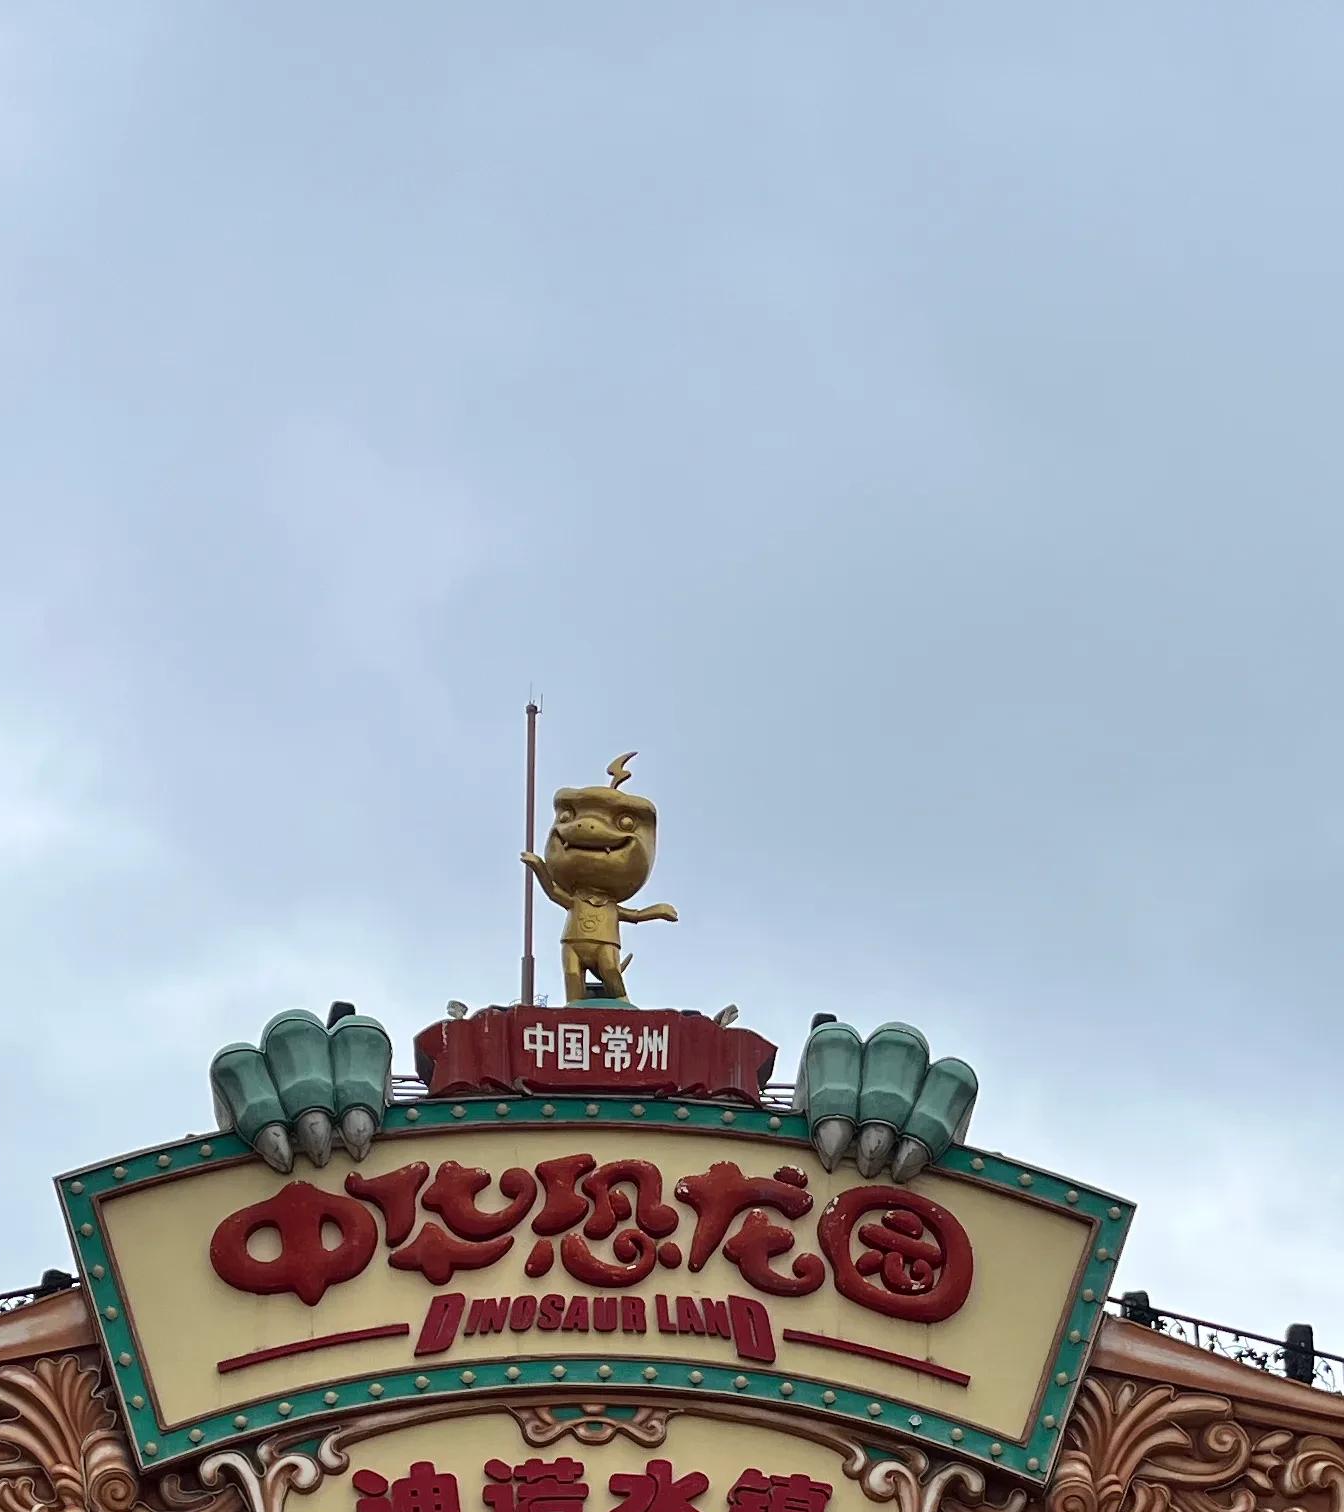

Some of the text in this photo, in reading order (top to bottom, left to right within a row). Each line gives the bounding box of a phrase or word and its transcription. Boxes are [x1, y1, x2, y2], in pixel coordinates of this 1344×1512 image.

[522, 1021, 670, 1073] 中国·常州
[209, 1152, 974, 1324] 中华恐龙园
[414, 1291, 776, 1364] DINOSAUR LAND
